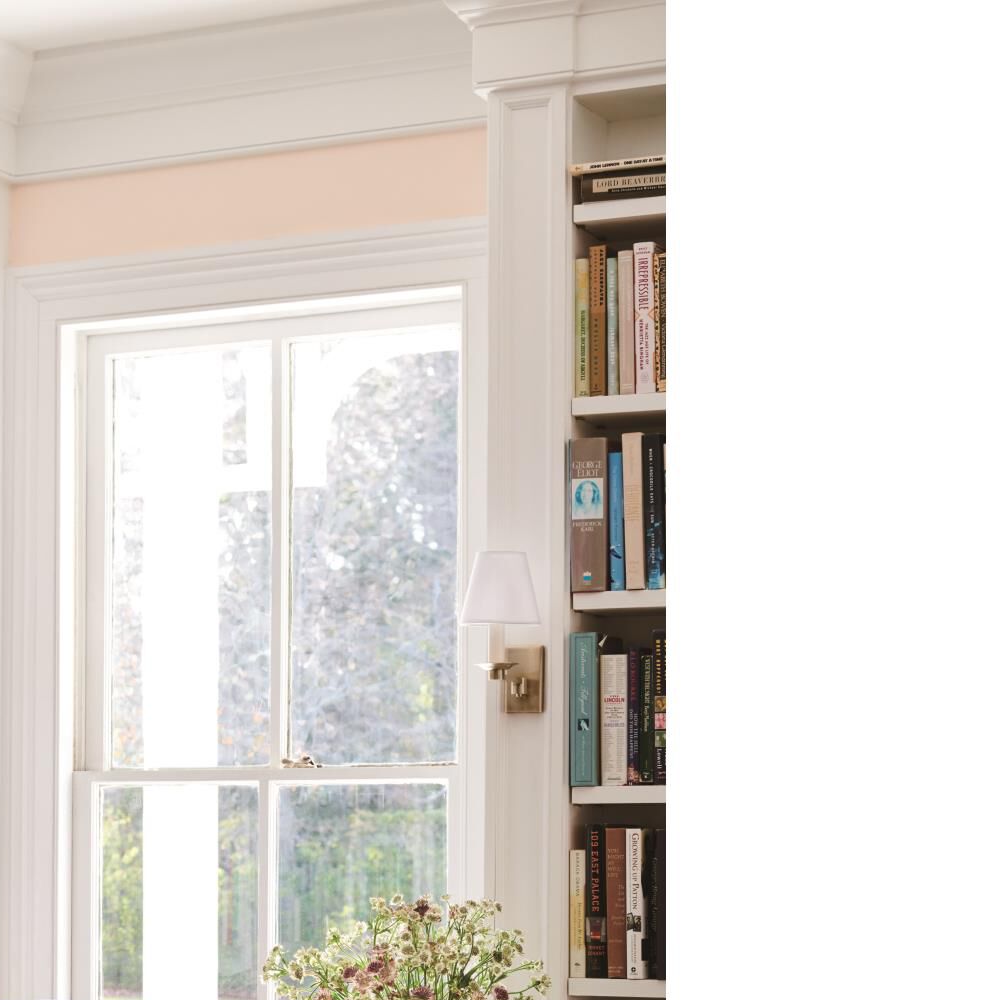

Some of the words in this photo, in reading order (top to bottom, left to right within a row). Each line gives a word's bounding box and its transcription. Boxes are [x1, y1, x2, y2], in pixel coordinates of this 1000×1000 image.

[595, 180, 618, 188] LORD
[638, 257, 649, 311] IRREPRESSIBLE
[572, 460, 602, 469] GEORGE
[577, 469, 599, 477] ELIOT
[591, 831, 599, 847] 109
[632, 833, 640, 871] GROWING
[591, 851, 599, 873] EAST
[632, 872, 638, 882] UP
[591, 878, 600, 912] PALACE
